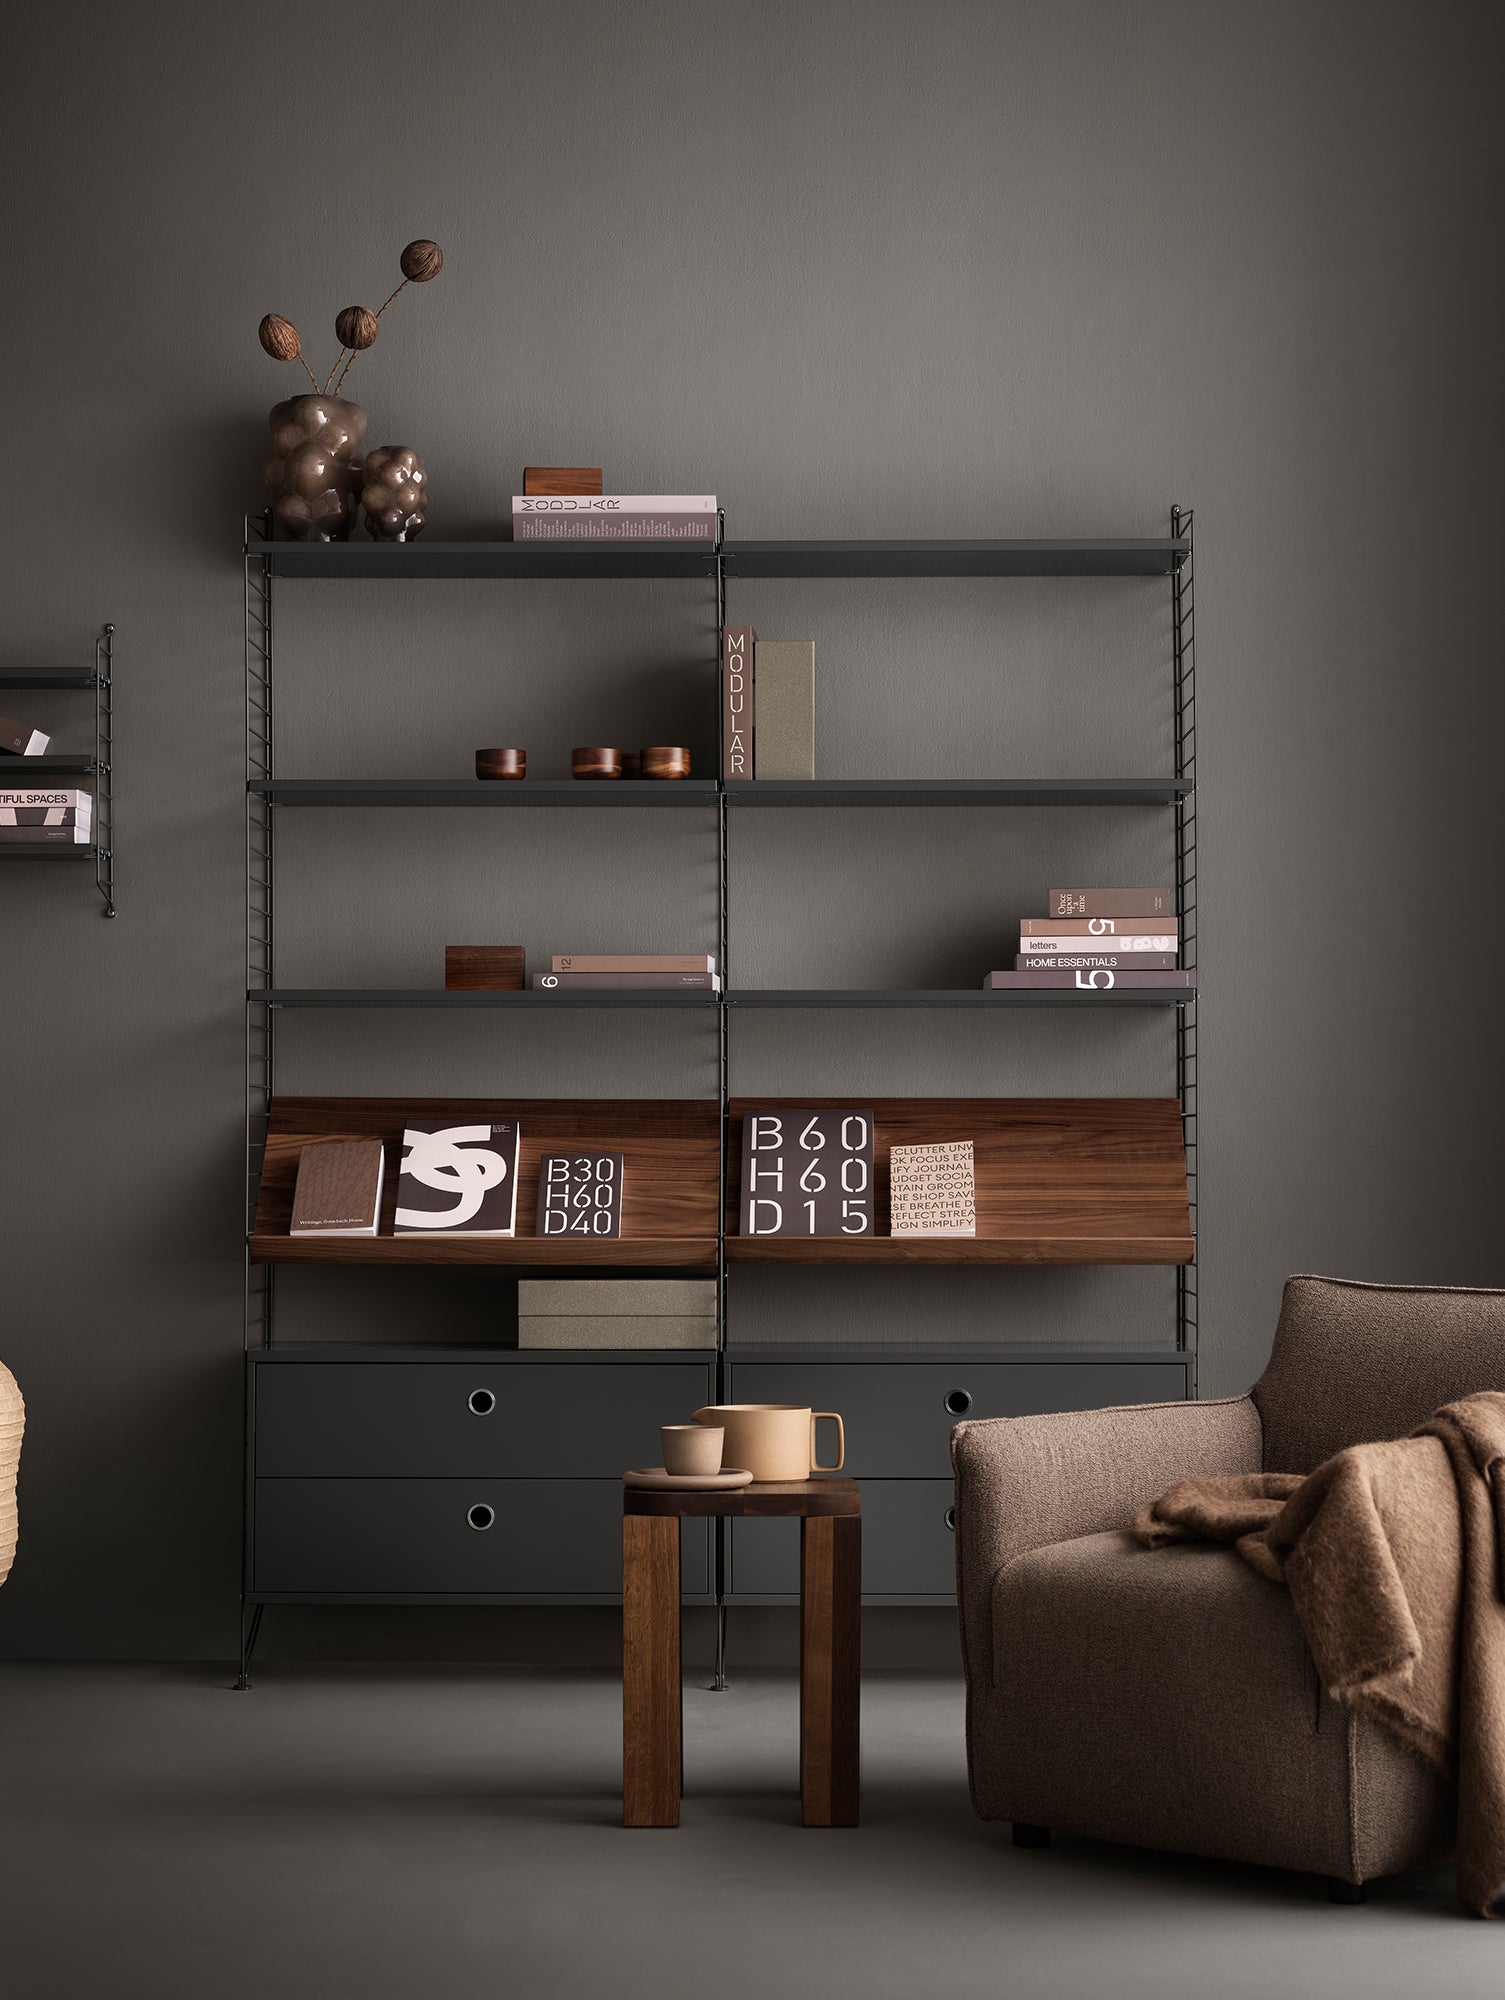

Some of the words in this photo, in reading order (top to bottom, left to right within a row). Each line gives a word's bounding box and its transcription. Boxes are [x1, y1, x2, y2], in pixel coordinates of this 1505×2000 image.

[521, 500, 620, 511] MODULAR
[728, 634, 745, 773] MODULAR
[26, 794, 68, 804] SPACES
[1057, 893, 1066, 915] Once
[1066, 893, 1075, 915] upon
[1088, 918, 1115, 936] 5
[1029, 941, 1058, 950] letters
[561, 958, 572, 971] 12
[1026, 958, 1056, 968] HOME
[1057, 957, 1118, 967] ESSENTIALS
[910, 1154, 950, 1164] FOCUS
[953, 1152, 974, 1161] EXE
[547, 1158, 614, 1183] B30
[890, 1165, 911, 1174] IFY
[914, 1163, 970, 1173] JOURNAL
[890, 1174, 932, 1183] UDGET
[935, 1172, 973, 1181] SOCIA
[927, 1181, 973, 1191] GROOM
[546, 1184, 613, 1208] H60
[912, 1192, 945, 1201] SHOP
[948, 1190, 975, 1199] SAVE
[890, 1203, 906, 1211] SE
[909, 1200, 961, 1211] BREATHE
[890, 1211, 936, 1220] REFLECT
[939, 1209, 976, 1218] STREA
[544, 1210, 612, 1234] D40
[922, 1218, 974, 1228] SIMPLIFY
